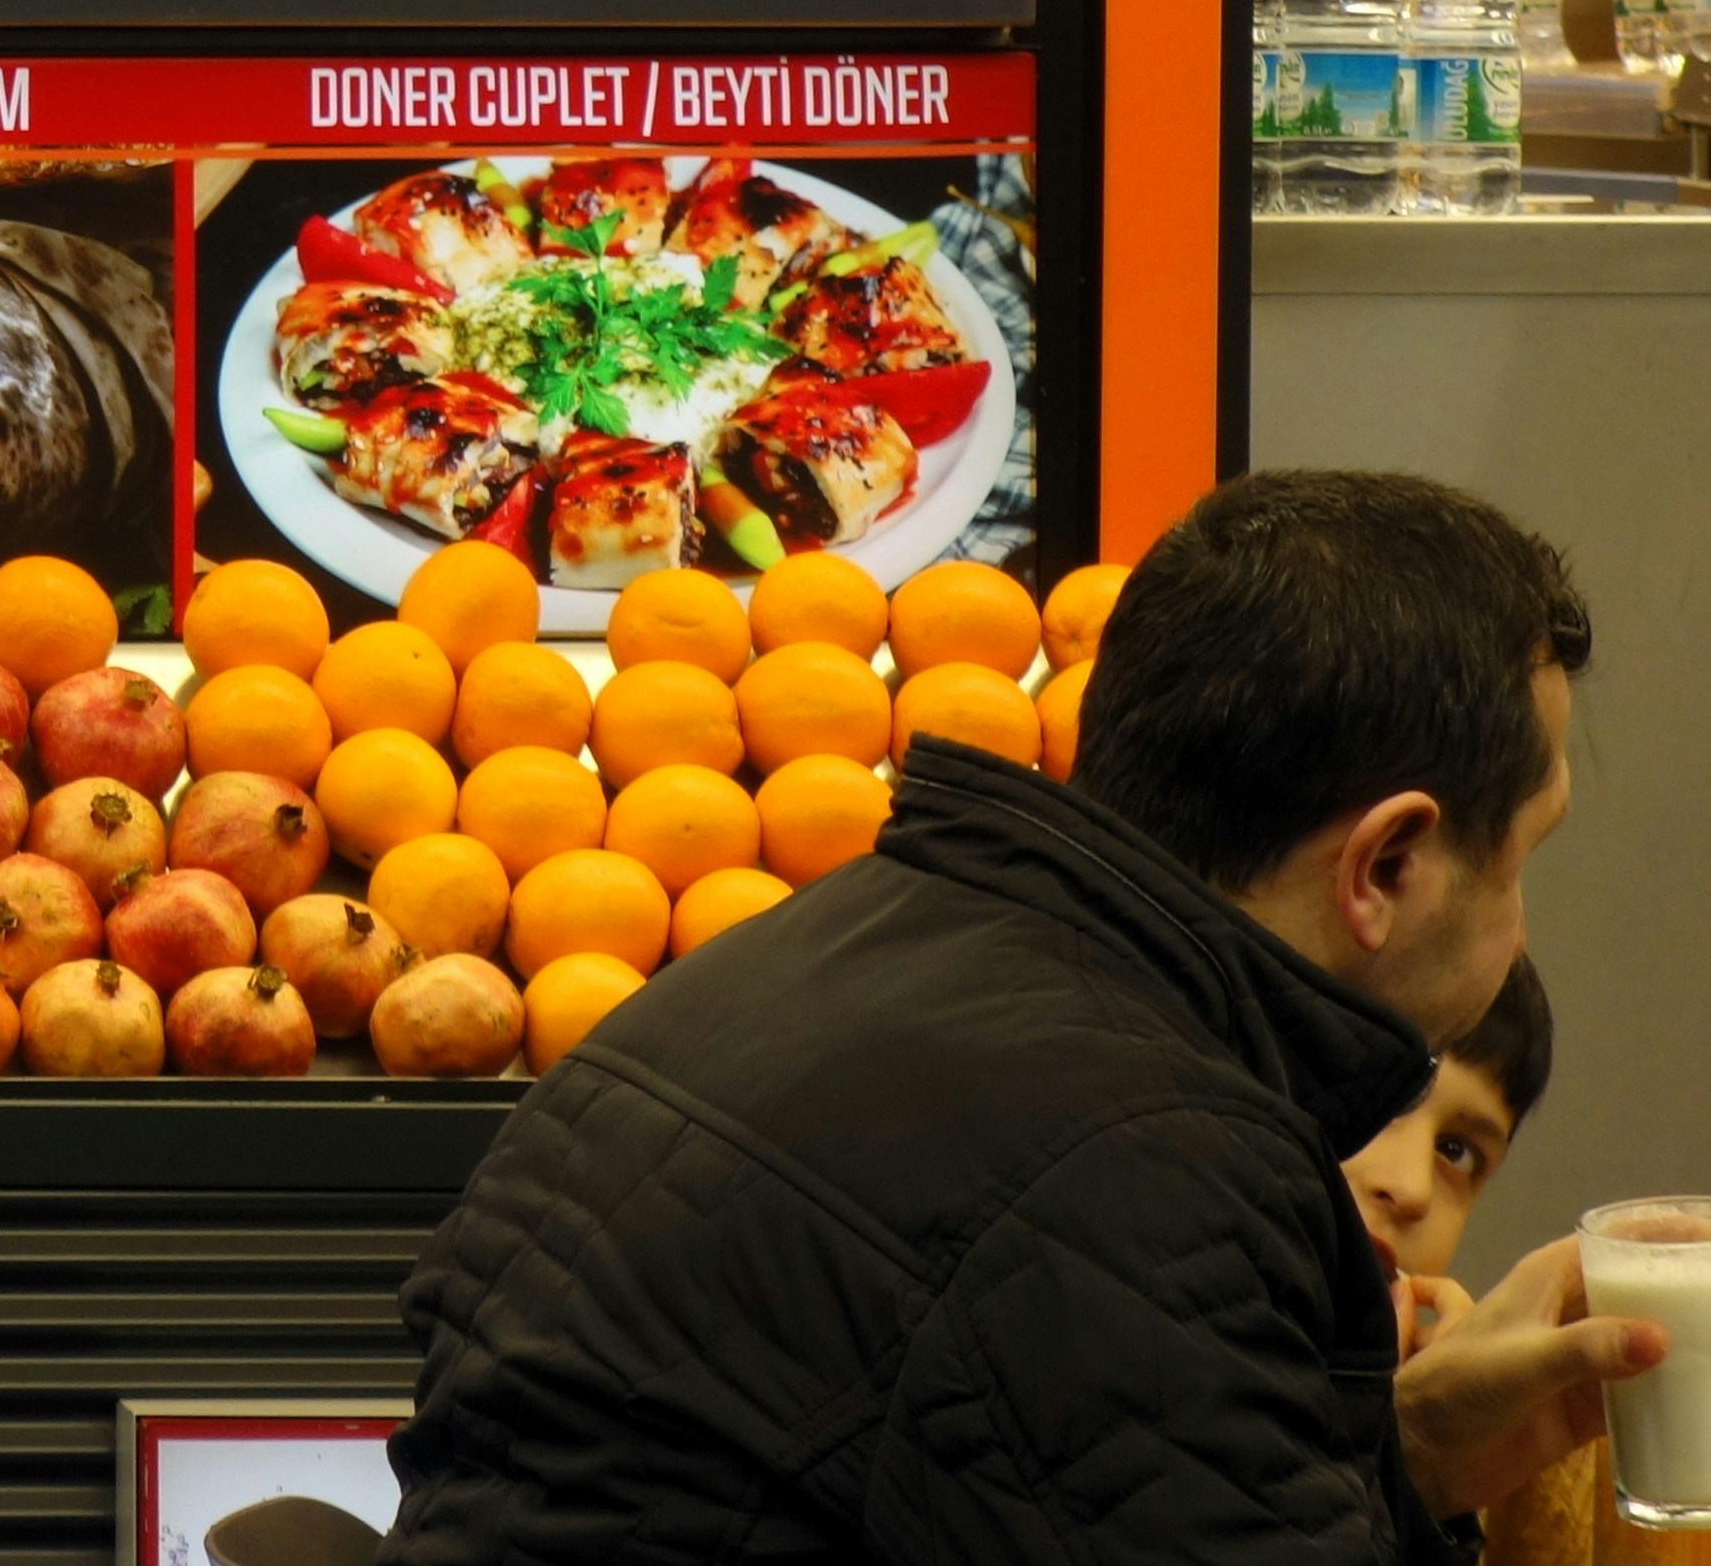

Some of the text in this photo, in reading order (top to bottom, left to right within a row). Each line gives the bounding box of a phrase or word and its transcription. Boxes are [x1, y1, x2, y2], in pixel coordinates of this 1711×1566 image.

[311, 56, 949, 136] DONER CUPLET / BEYTİ DÖNER
